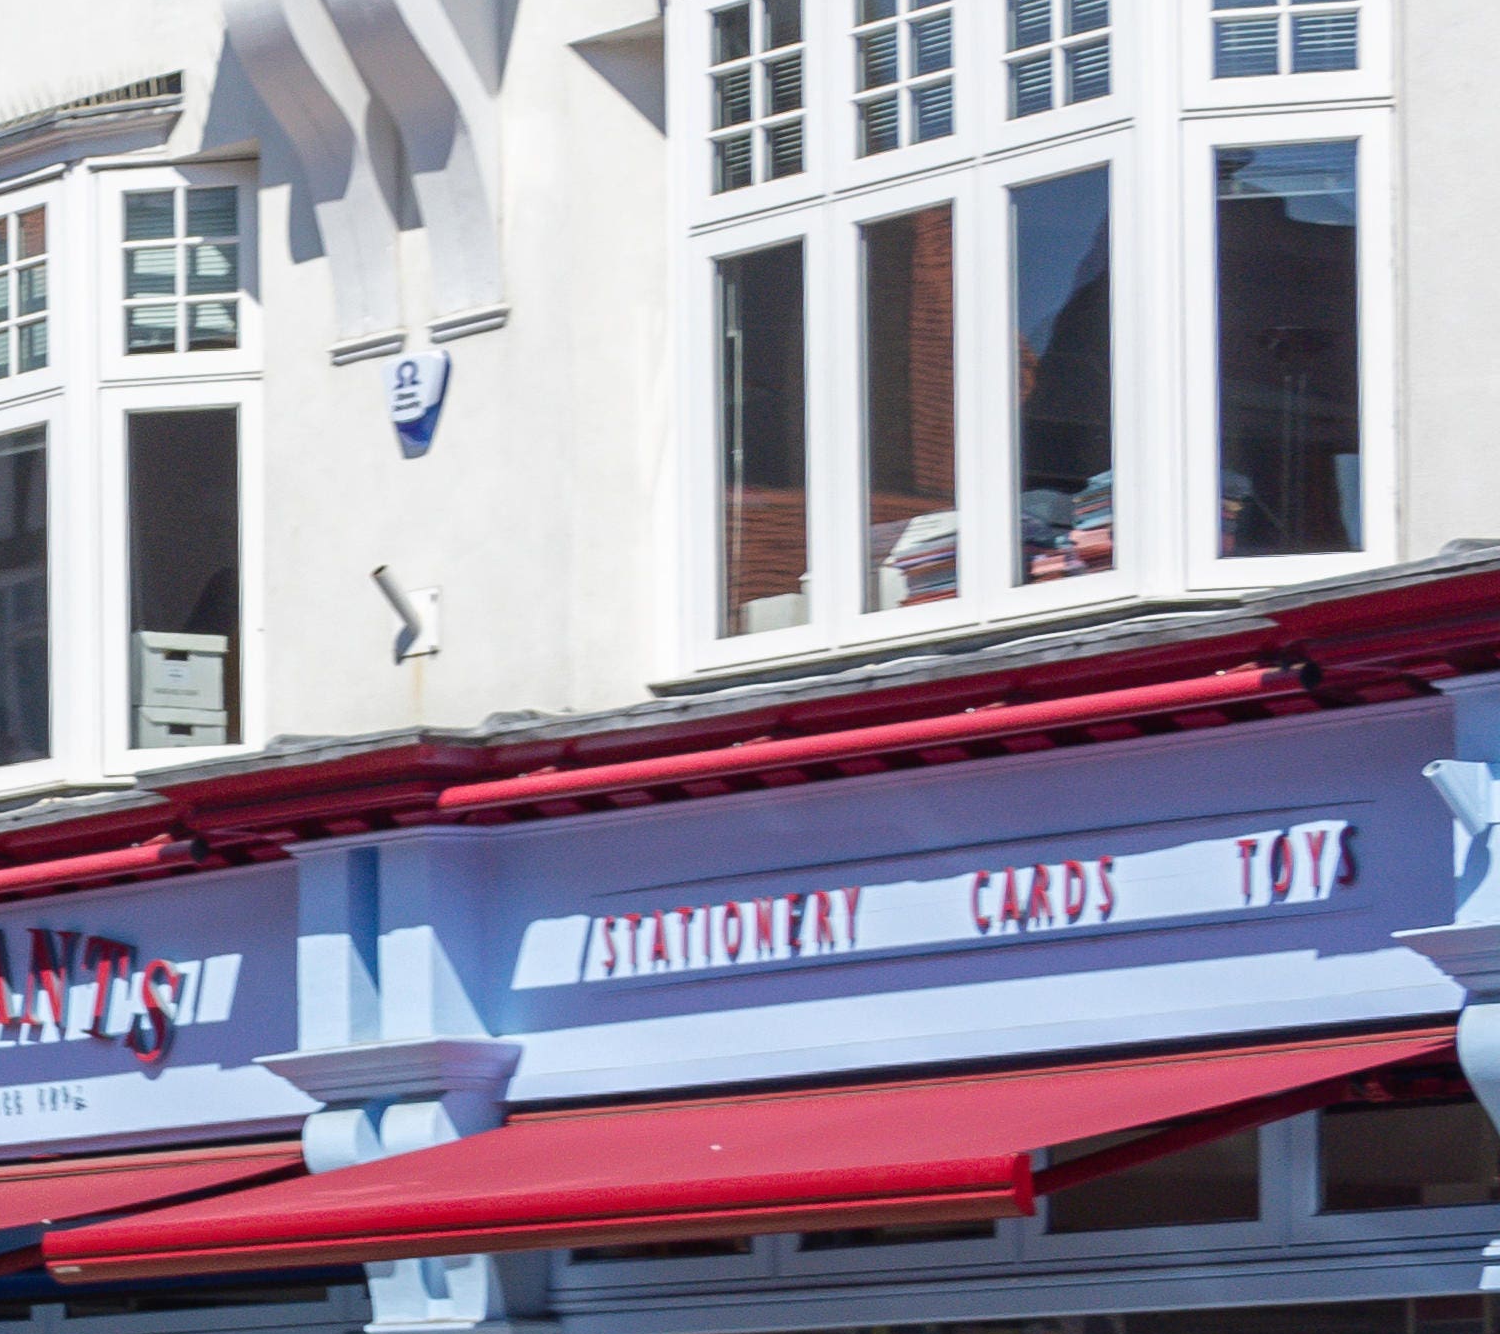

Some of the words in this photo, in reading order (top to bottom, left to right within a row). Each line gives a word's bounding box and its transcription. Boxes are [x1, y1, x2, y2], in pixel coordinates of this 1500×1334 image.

[601, 887, 861, 975] STATIONERY
[970, 856, 1117, 934] CARDS
[1237, 824, 1359, 901] TOYS
